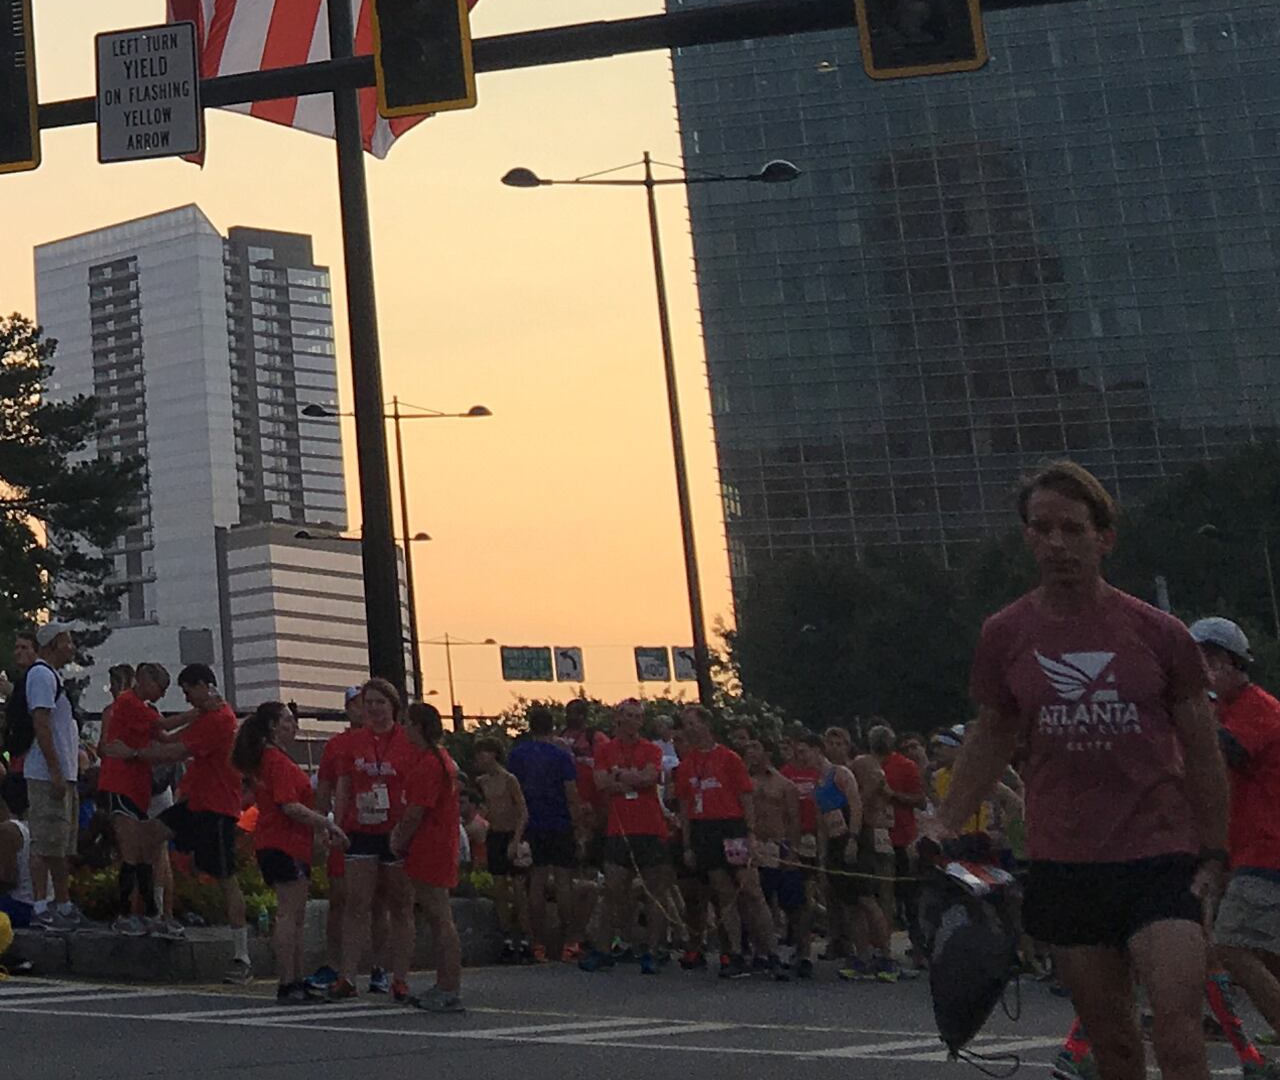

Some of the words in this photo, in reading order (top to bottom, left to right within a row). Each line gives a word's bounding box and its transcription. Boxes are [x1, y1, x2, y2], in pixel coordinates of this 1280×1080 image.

[112, 38, 139, 57] LEFT
[147, 33, 178, 52] TURN
[123, 56, 168, 79] YIELD
[105, 88, 121, 106] ON
[129, 81, 190, 103] FLASHING
[123, 107, 172, 127] YELLOW
[127, 131, 170, 150] ARROW
[1039, 702, 1140, 725] ATLANTA
